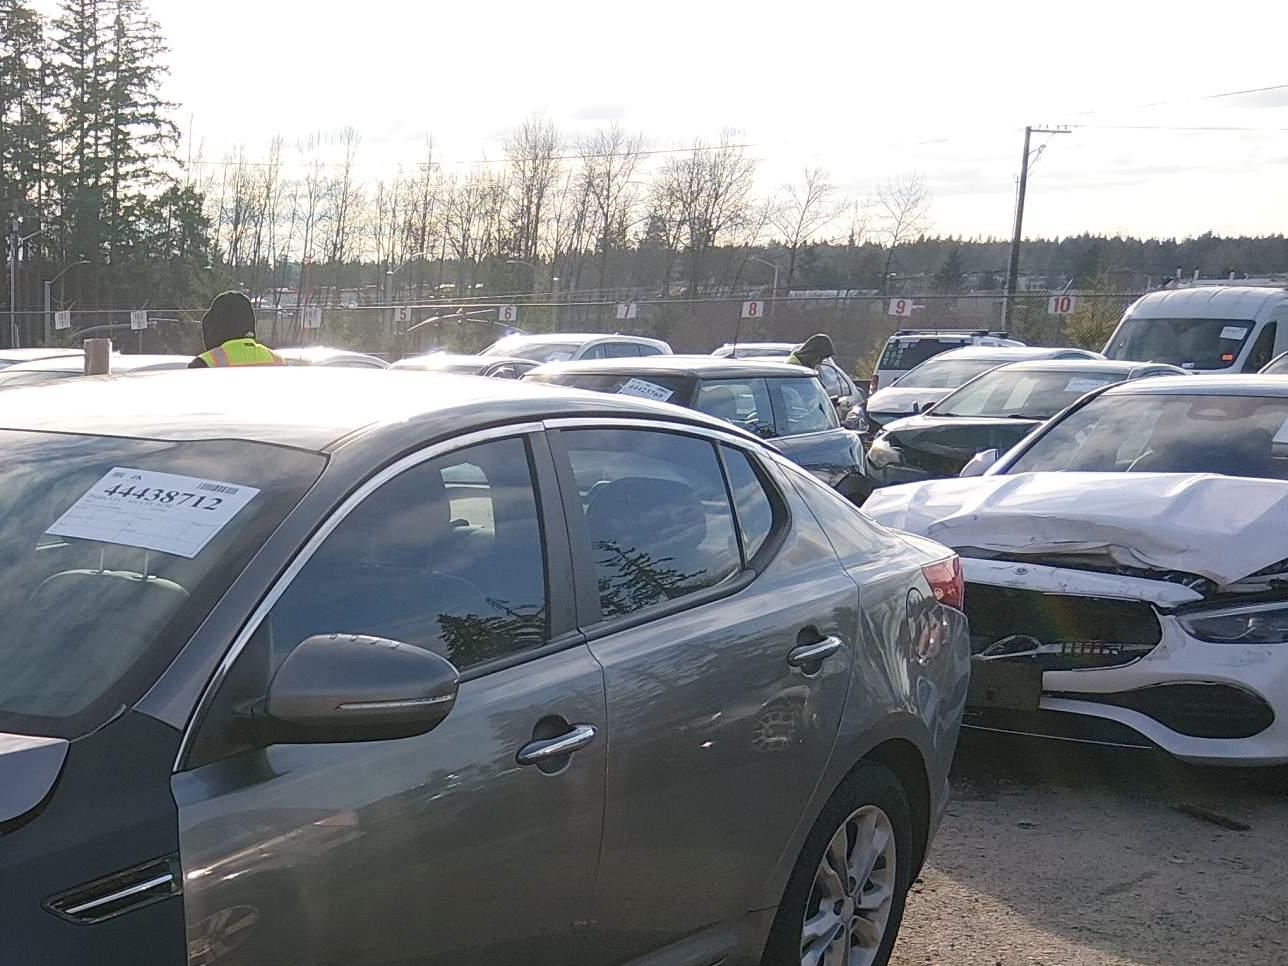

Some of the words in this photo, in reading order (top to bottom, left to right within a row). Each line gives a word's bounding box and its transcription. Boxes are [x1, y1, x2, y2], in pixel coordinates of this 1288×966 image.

[623, 304, 631, 318] 7
[748, 302, 758, 317] 8
[895, 300, 906, 315] 9
[1053, 296, 1071, 313] 10
[399, 307, 407, 321] 5
[504, 307, 512, 320] 6
[103, 483, 224, 511] 44438712
